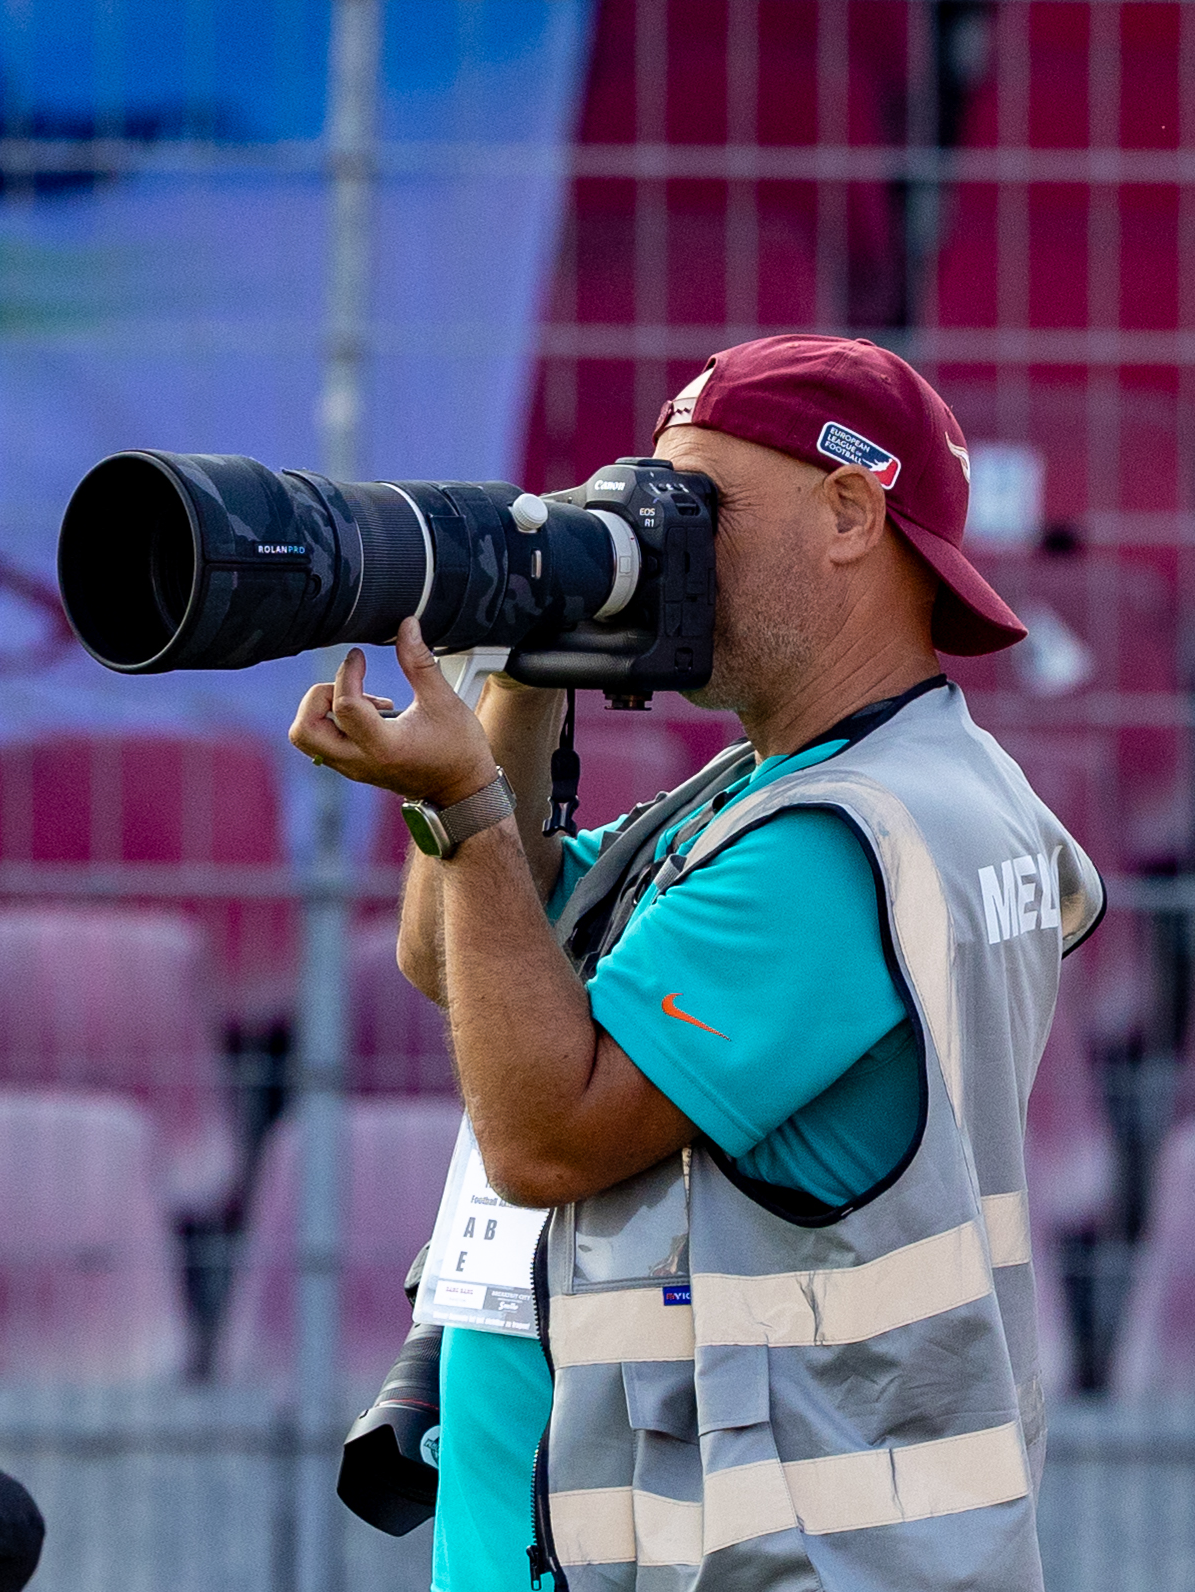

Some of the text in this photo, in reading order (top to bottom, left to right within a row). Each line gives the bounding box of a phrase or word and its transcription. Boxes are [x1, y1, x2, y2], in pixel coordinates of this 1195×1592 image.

[827, 434, 857, 454] LEAGUE
[830, 427, 870, 453] EUROPEAN
[824, 441, 863, 465] FOOTBALL
[594, 479, 625, 491] Canon
[639, 508, 655, 516] EOS
[644, 519, 654, 527] R1
[258, 545, 305, 554] ROLANPRO
[463, 1216, 497, 1240] A B
[456, 1251, 467, 1272] E
